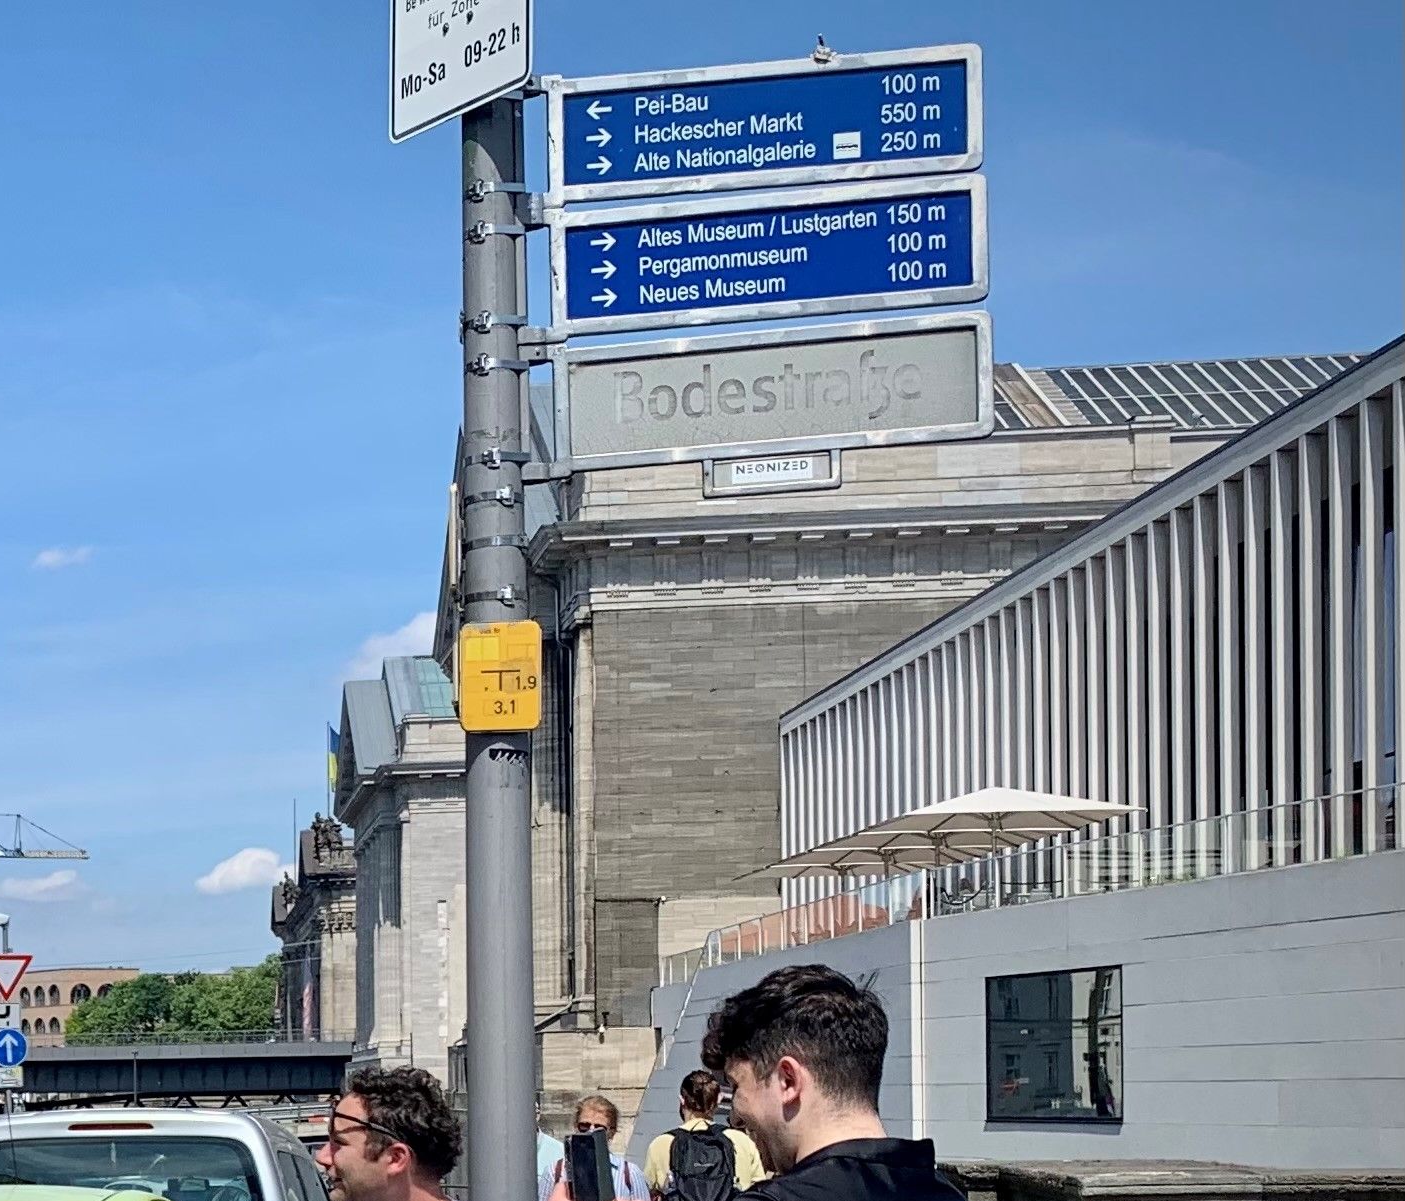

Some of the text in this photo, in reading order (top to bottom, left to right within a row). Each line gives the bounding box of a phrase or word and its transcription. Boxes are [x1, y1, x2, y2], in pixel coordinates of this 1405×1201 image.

[428, 10, 444, 29] für
[401, 22, 520, 99] Mo-Sa 09-22 h
[634, 73, 940, 116] Pei-Bau 100 m
[634, 102, 941, 144] Hackescher Markt 550 m
[634, 130, 941, 172] Alte Nationalgalerie 250 m
[637, 203, 946, 248] Altes Museum / Lustgarten 150 m
[639, 231, 946, 279] Pergamonmuseum 100 m
[639, 260, 947, 305] Neues Museum 100 m
[613, 349, 923, 424] Bodestraße
[735, 460, 809, 475] NEONIZED
[515, 675, 537, 691] 1.9
[494, 699, 516, 715] 3.1
